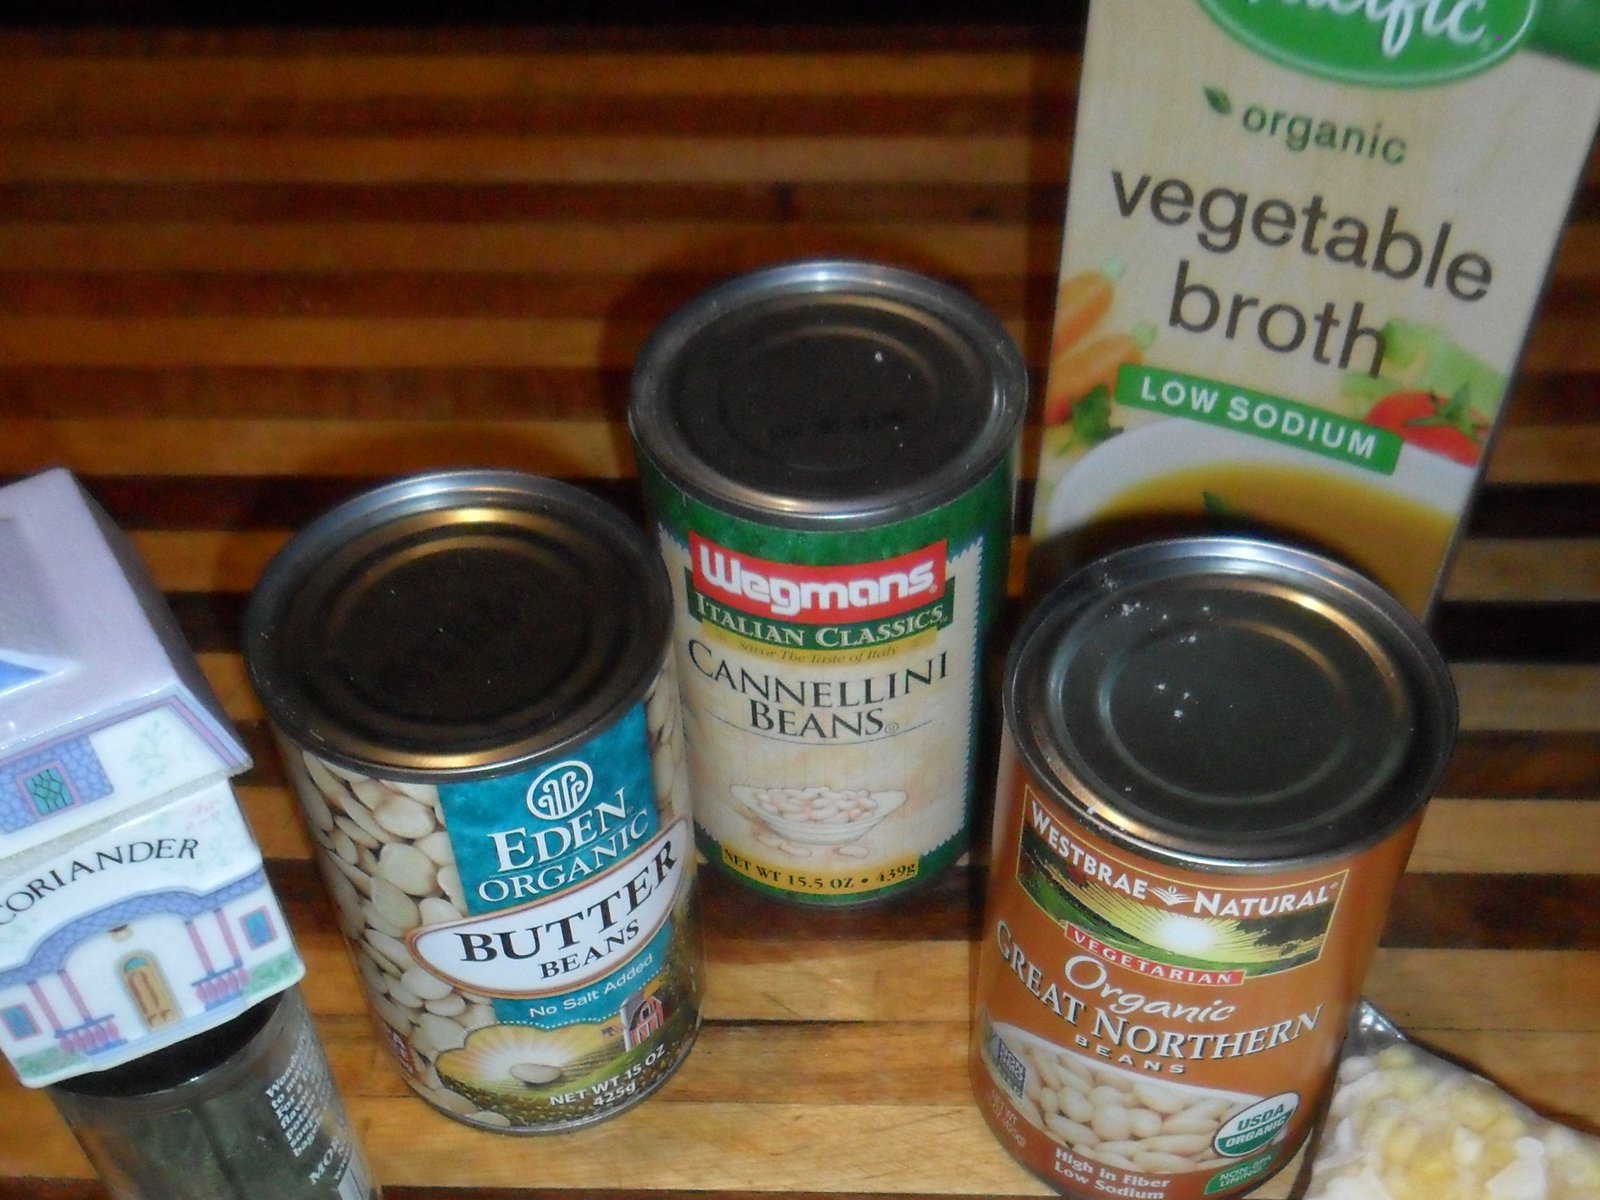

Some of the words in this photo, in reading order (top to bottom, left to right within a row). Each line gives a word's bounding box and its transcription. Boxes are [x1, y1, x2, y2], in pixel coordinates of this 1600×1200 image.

[1242, 104, 1407, 165] organic
[1110, 170, 1493, 302] vegetable
[1168, 259, 1387, 378] broth
[1140, 376, 1218, 415] LOW
[1227, 396, 1377, 460] SODIUM
[699, 544, 935, 617] Wegmans
[696, 591, 805, 647] ITALIAN
[814, 604, 943, 648] CLASSICS
[688, 638, 949, 708] CANNELLINI
[782, 650, 805, 662] The
[811, 651, 847, 664] Taste
[849, 650, 864, 664] of
[868, 645, 899, 660] Italy
[748, 699, 884, 739] BEANS
[478, 809, 649, 902] ORGANIC
[487, 787, 626, 873] EDEN
[1031, 799, 1149, 901] WESTBRAE
[1193, 886, 1328, 918] NATURAL
[724, 847, 751, 871] NET
[757, 865, 782, 882] WT
[788, 875, 824, 889] 15.5
[830, 876, 855, 889] OZ
[876, 862, 916, 883] 439g
[454, 839, 678, 963] BUTTER
[538, 919, 642, 980] BEANS
[1073, 931, 1234, 985] VEGETARIAN
[529, 1005, 557, 1018] No
[563, 989, 600, 1011] Salt
[604, 952, 654, 996] Added
[995, 919, 1087, 1028] GREAT
[1091, 1003, 1324, 1062] NORTHERN
[1064, 954, 1236, 1024] Organic
[549, 1088, 588, 1106] NET
[592, 1075, 620, 1095] WT
[624, 1063, 642, 1079] 15
[645, 1042, 666, 1066] OZ
[1074, 1033, 1187, 1075] BEANS
[593, 1080, 636, 1107] 425g
[1237, 1103, 1285, 1132] USDA
[1225, 1114, 1289, 1149] ORGANIC
[1054, 1160, 1090, 1185] Low
[1094, 1179, 1165, 1200] Sodium
[1055, 1147, 1094, 1174] High
[1099, 1167, 1117, 1182] in
[1123, 1173, 1171, 1189] Fiber
